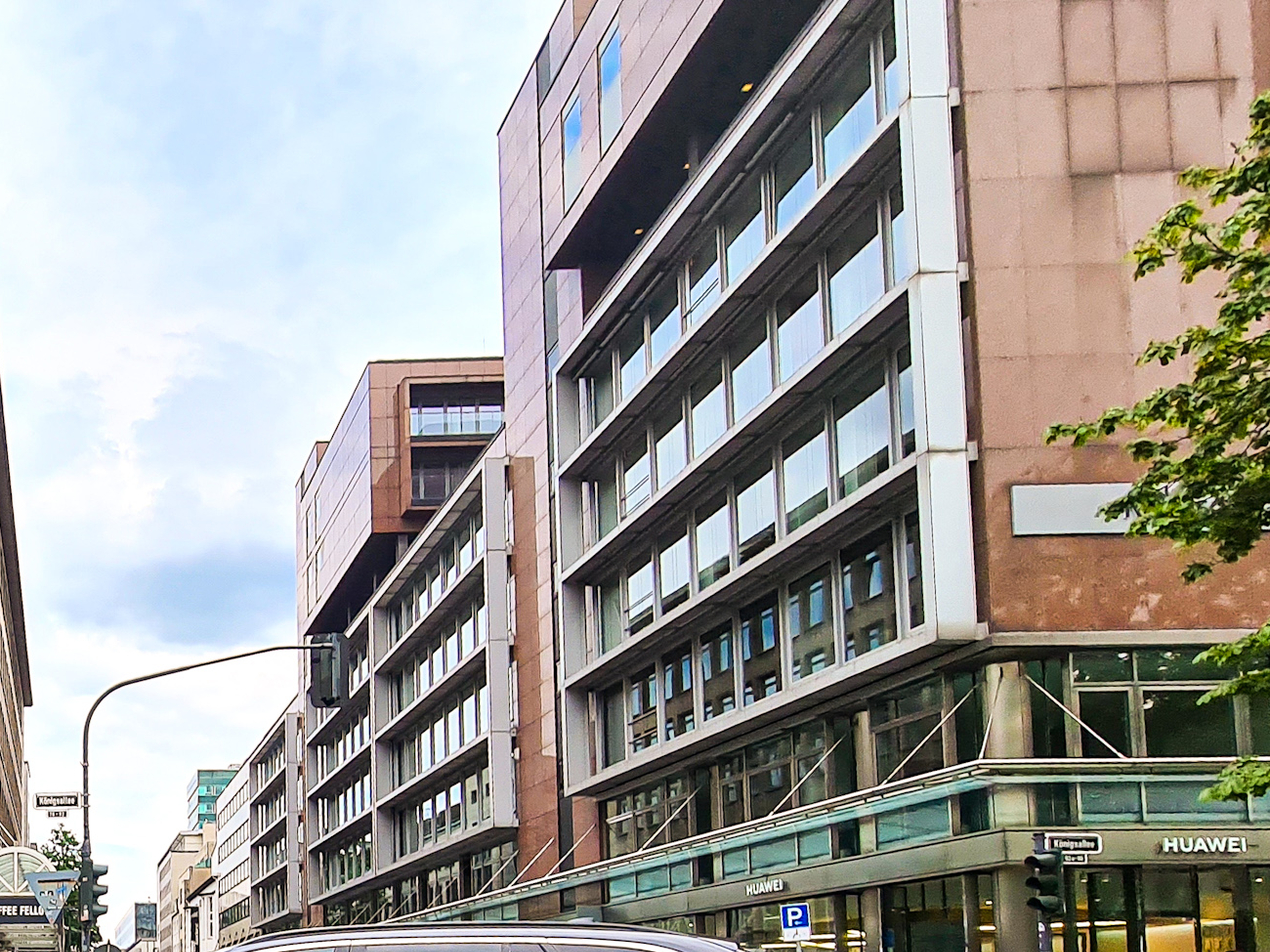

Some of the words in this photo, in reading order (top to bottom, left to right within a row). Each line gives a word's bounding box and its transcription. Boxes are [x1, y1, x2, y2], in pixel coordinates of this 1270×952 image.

[1053, 839, 1096, 850] Königsallee
[1162, 837, 1248, 853] HUAWEI
[746, 878, 784, 896] HUAWEI
[19, 905, 46, 916] FELLO
